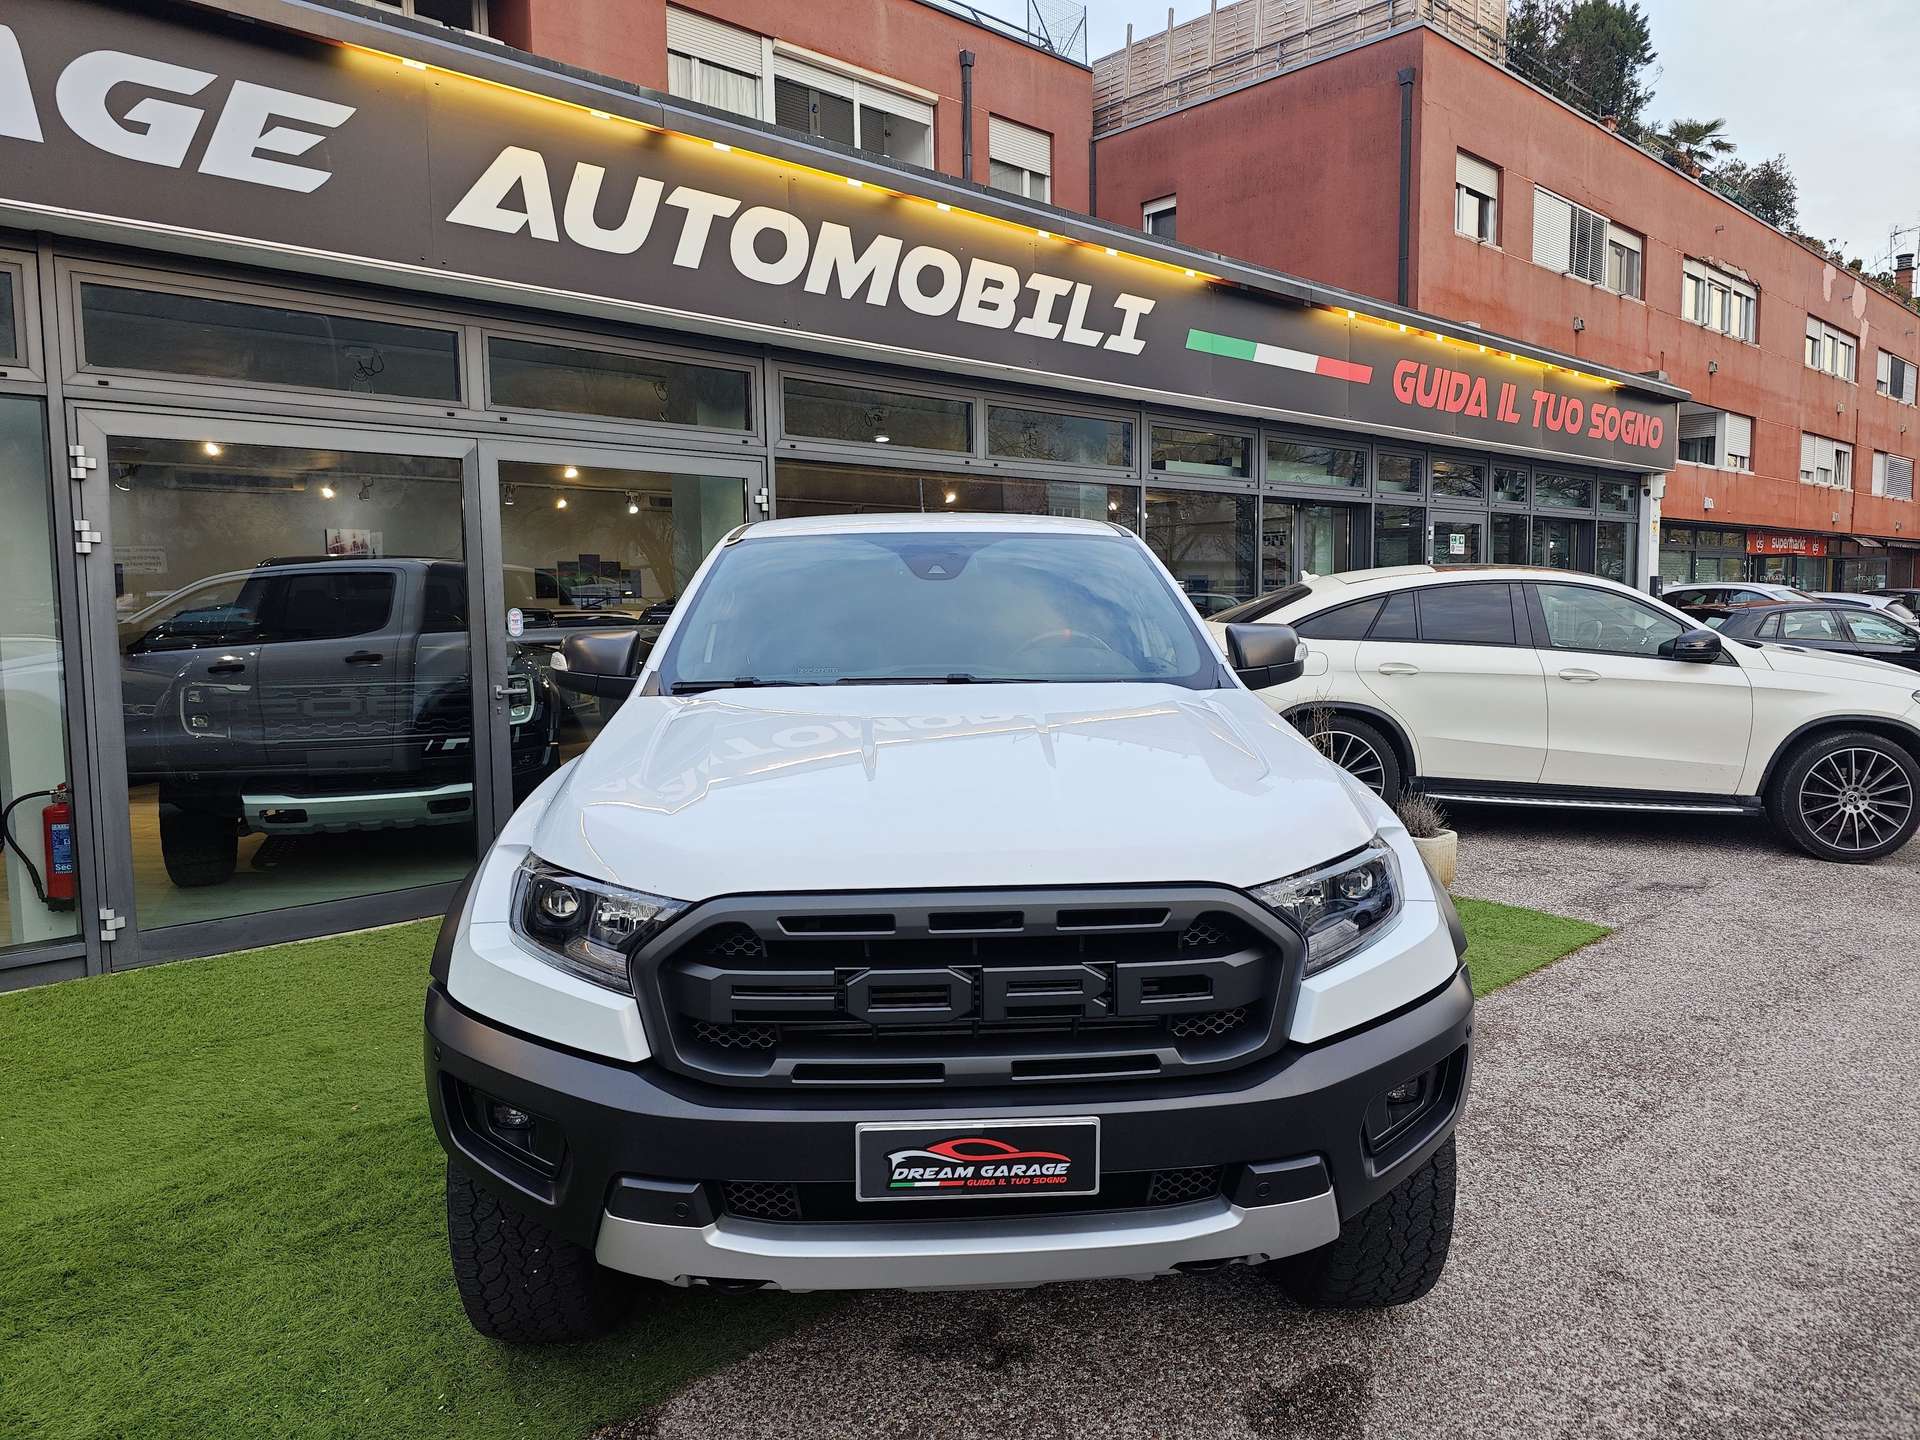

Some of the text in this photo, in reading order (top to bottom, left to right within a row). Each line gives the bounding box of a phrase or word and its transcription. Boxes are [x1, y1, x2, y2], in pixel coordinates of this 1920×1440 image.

[445, 145, 1156, 355] AUTOMOBILI
[1393, 359, 1664, 449] GUIDA IL TUO SOGNO
[692, 961, 1255, 1023] FORD
[891, 1163, 1071, 1180] DREAM GARAGE
[1010, 1177, 1031, 1185] TUO
[1033, 1176, 1068, 1184] SOGNO
